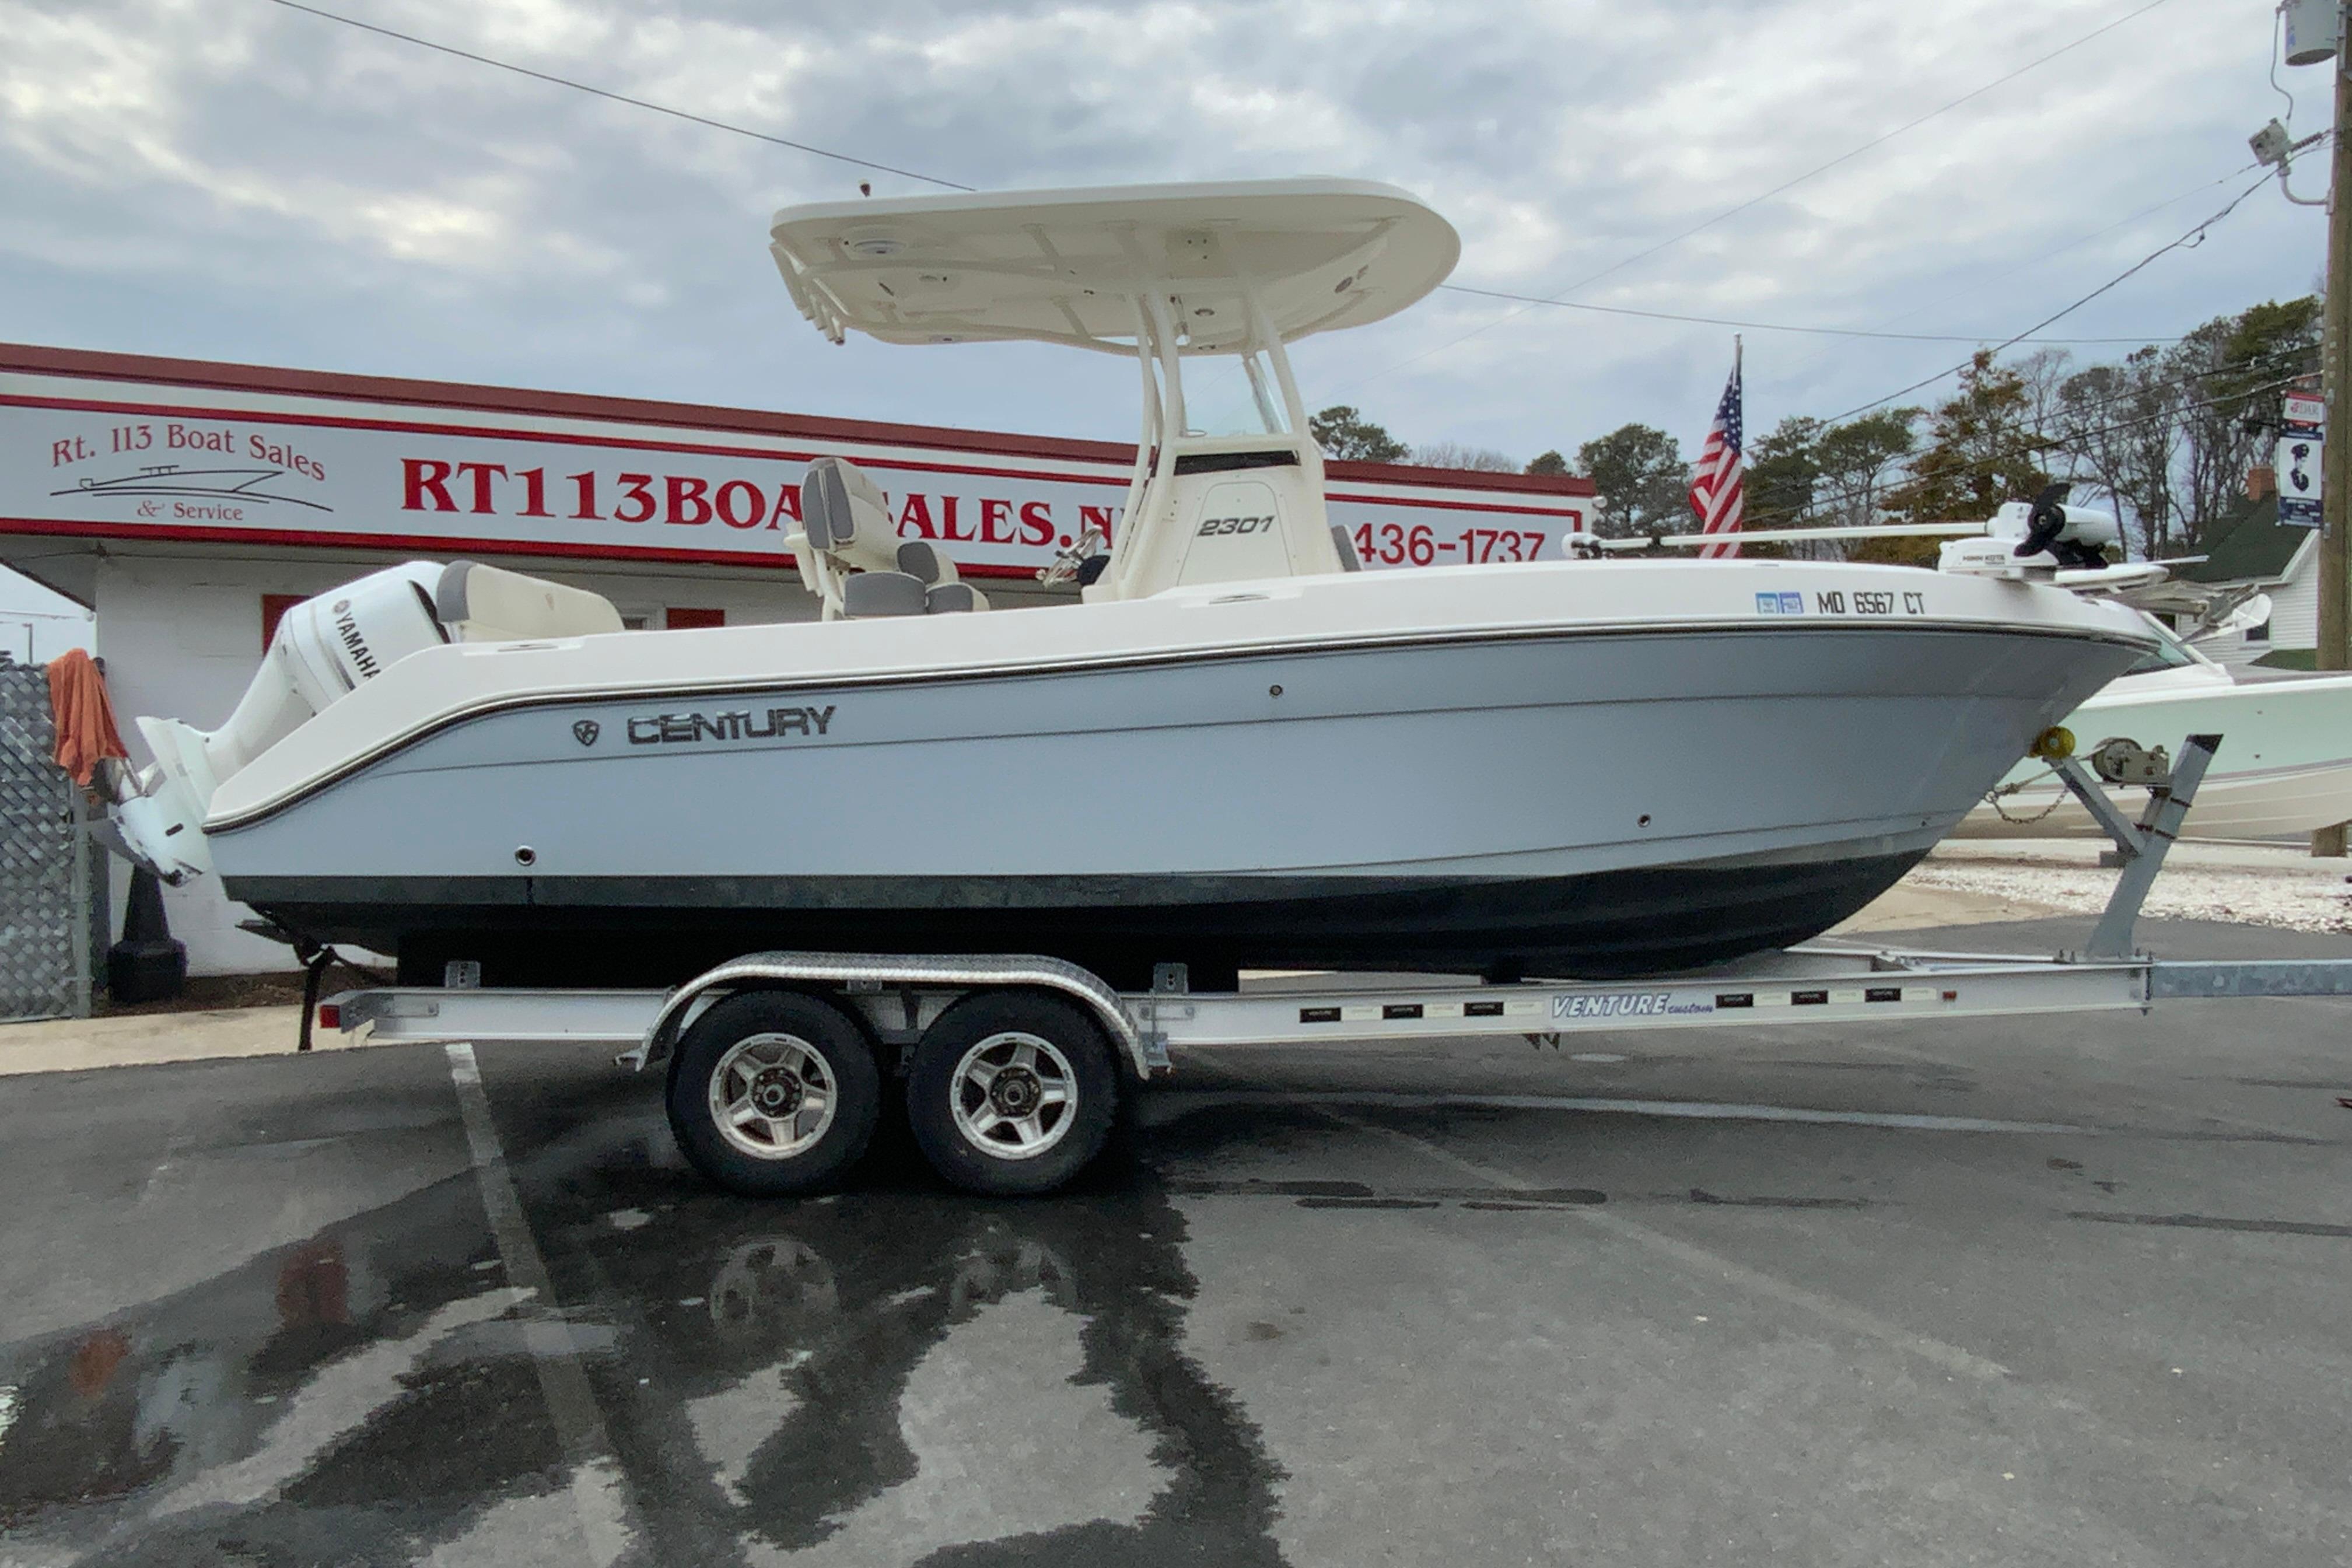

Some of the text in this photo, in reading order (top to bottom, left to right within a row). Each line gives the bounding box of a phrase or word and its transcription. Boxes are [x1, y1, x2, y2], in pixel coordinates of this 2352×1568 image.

[52, 424, 326, 481] Rt. 113 Boat Sales
[137, 501, 243, 521] & Service
[1197, 515, 1275, 536] 2301
[1354, 523, 1545, 565] 436-1737
[1853, 592, 1894, 614] 6567
[1903, 593, 1925, 614] CT
[336, 611, 380, 680] YAMAHA
[628, 705, 836, 744] CENTURY
[1552, 993, 1713, 1019] VENTURE custom
